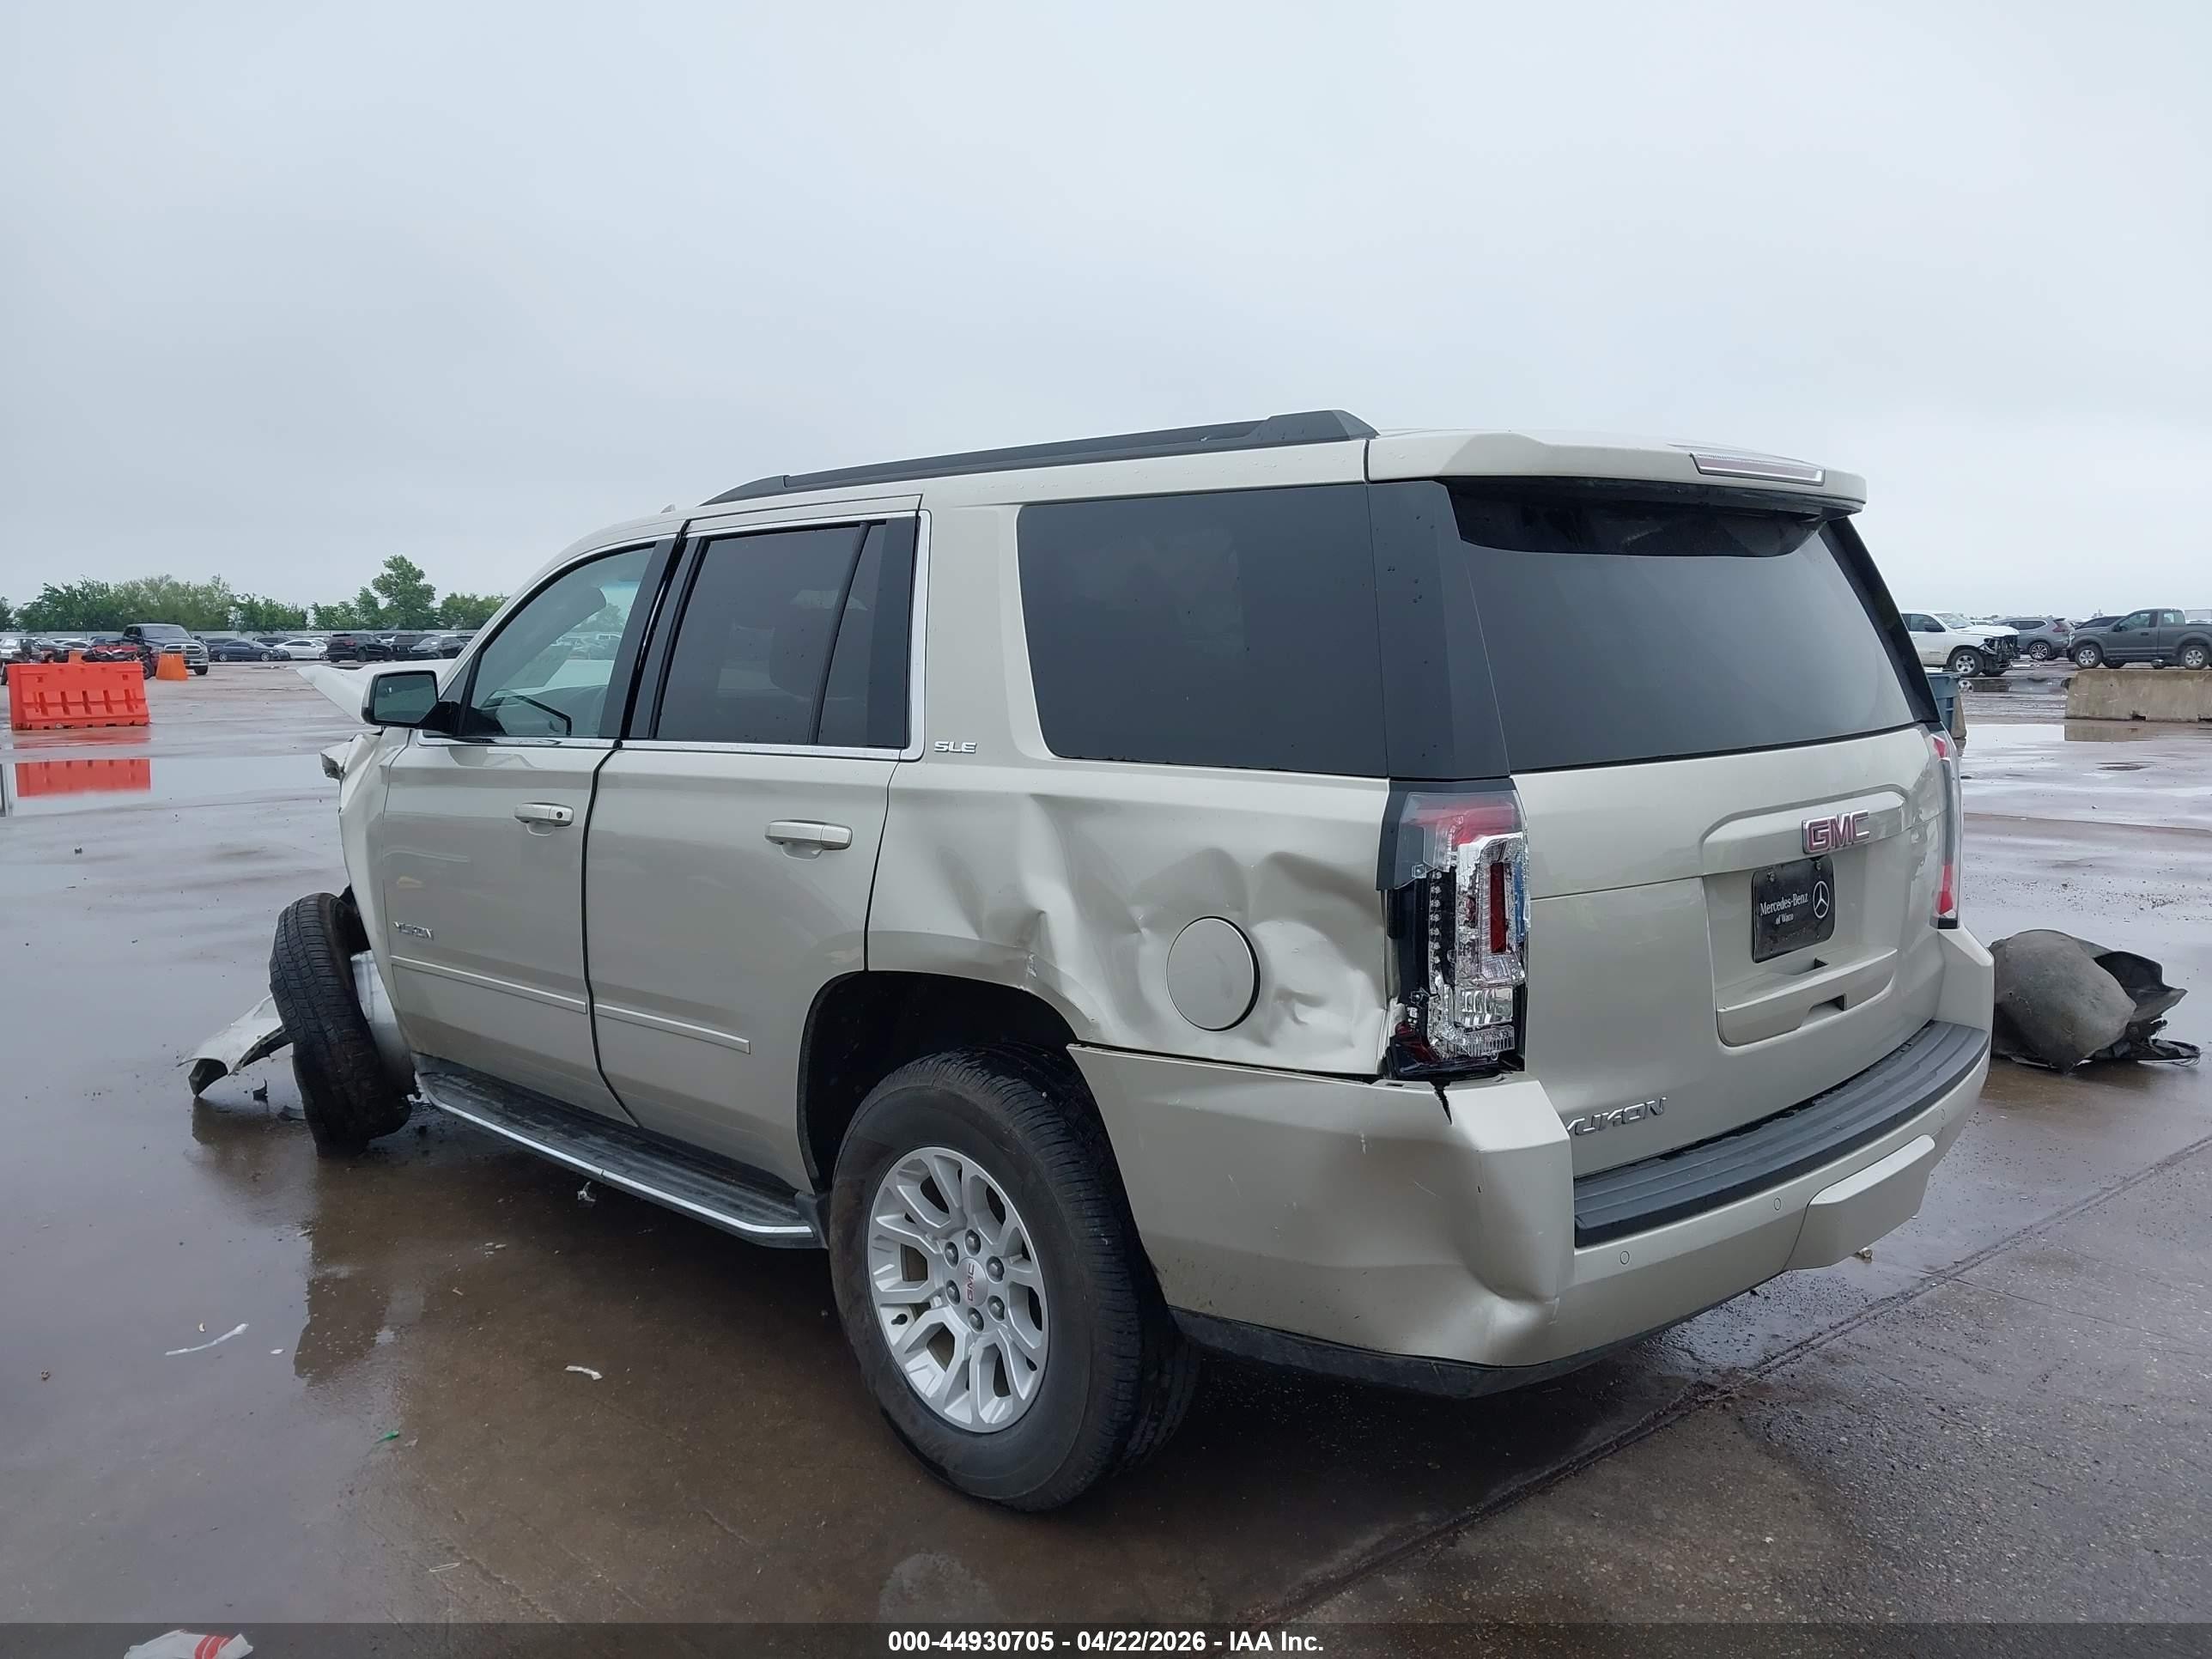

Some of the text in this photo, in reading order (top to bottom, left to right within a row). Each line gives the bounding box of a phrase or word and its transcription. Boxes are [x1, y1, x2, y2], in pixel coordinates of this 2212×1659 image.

[933, 740, 977, 754] SLE
[1802, 809, 1870, 854] GMC
[1759, 893, 1808, 916] Mercedes-Benz
[1775, 915, 1782, 925] of
[967, 1262, 975, 1302] GMC
